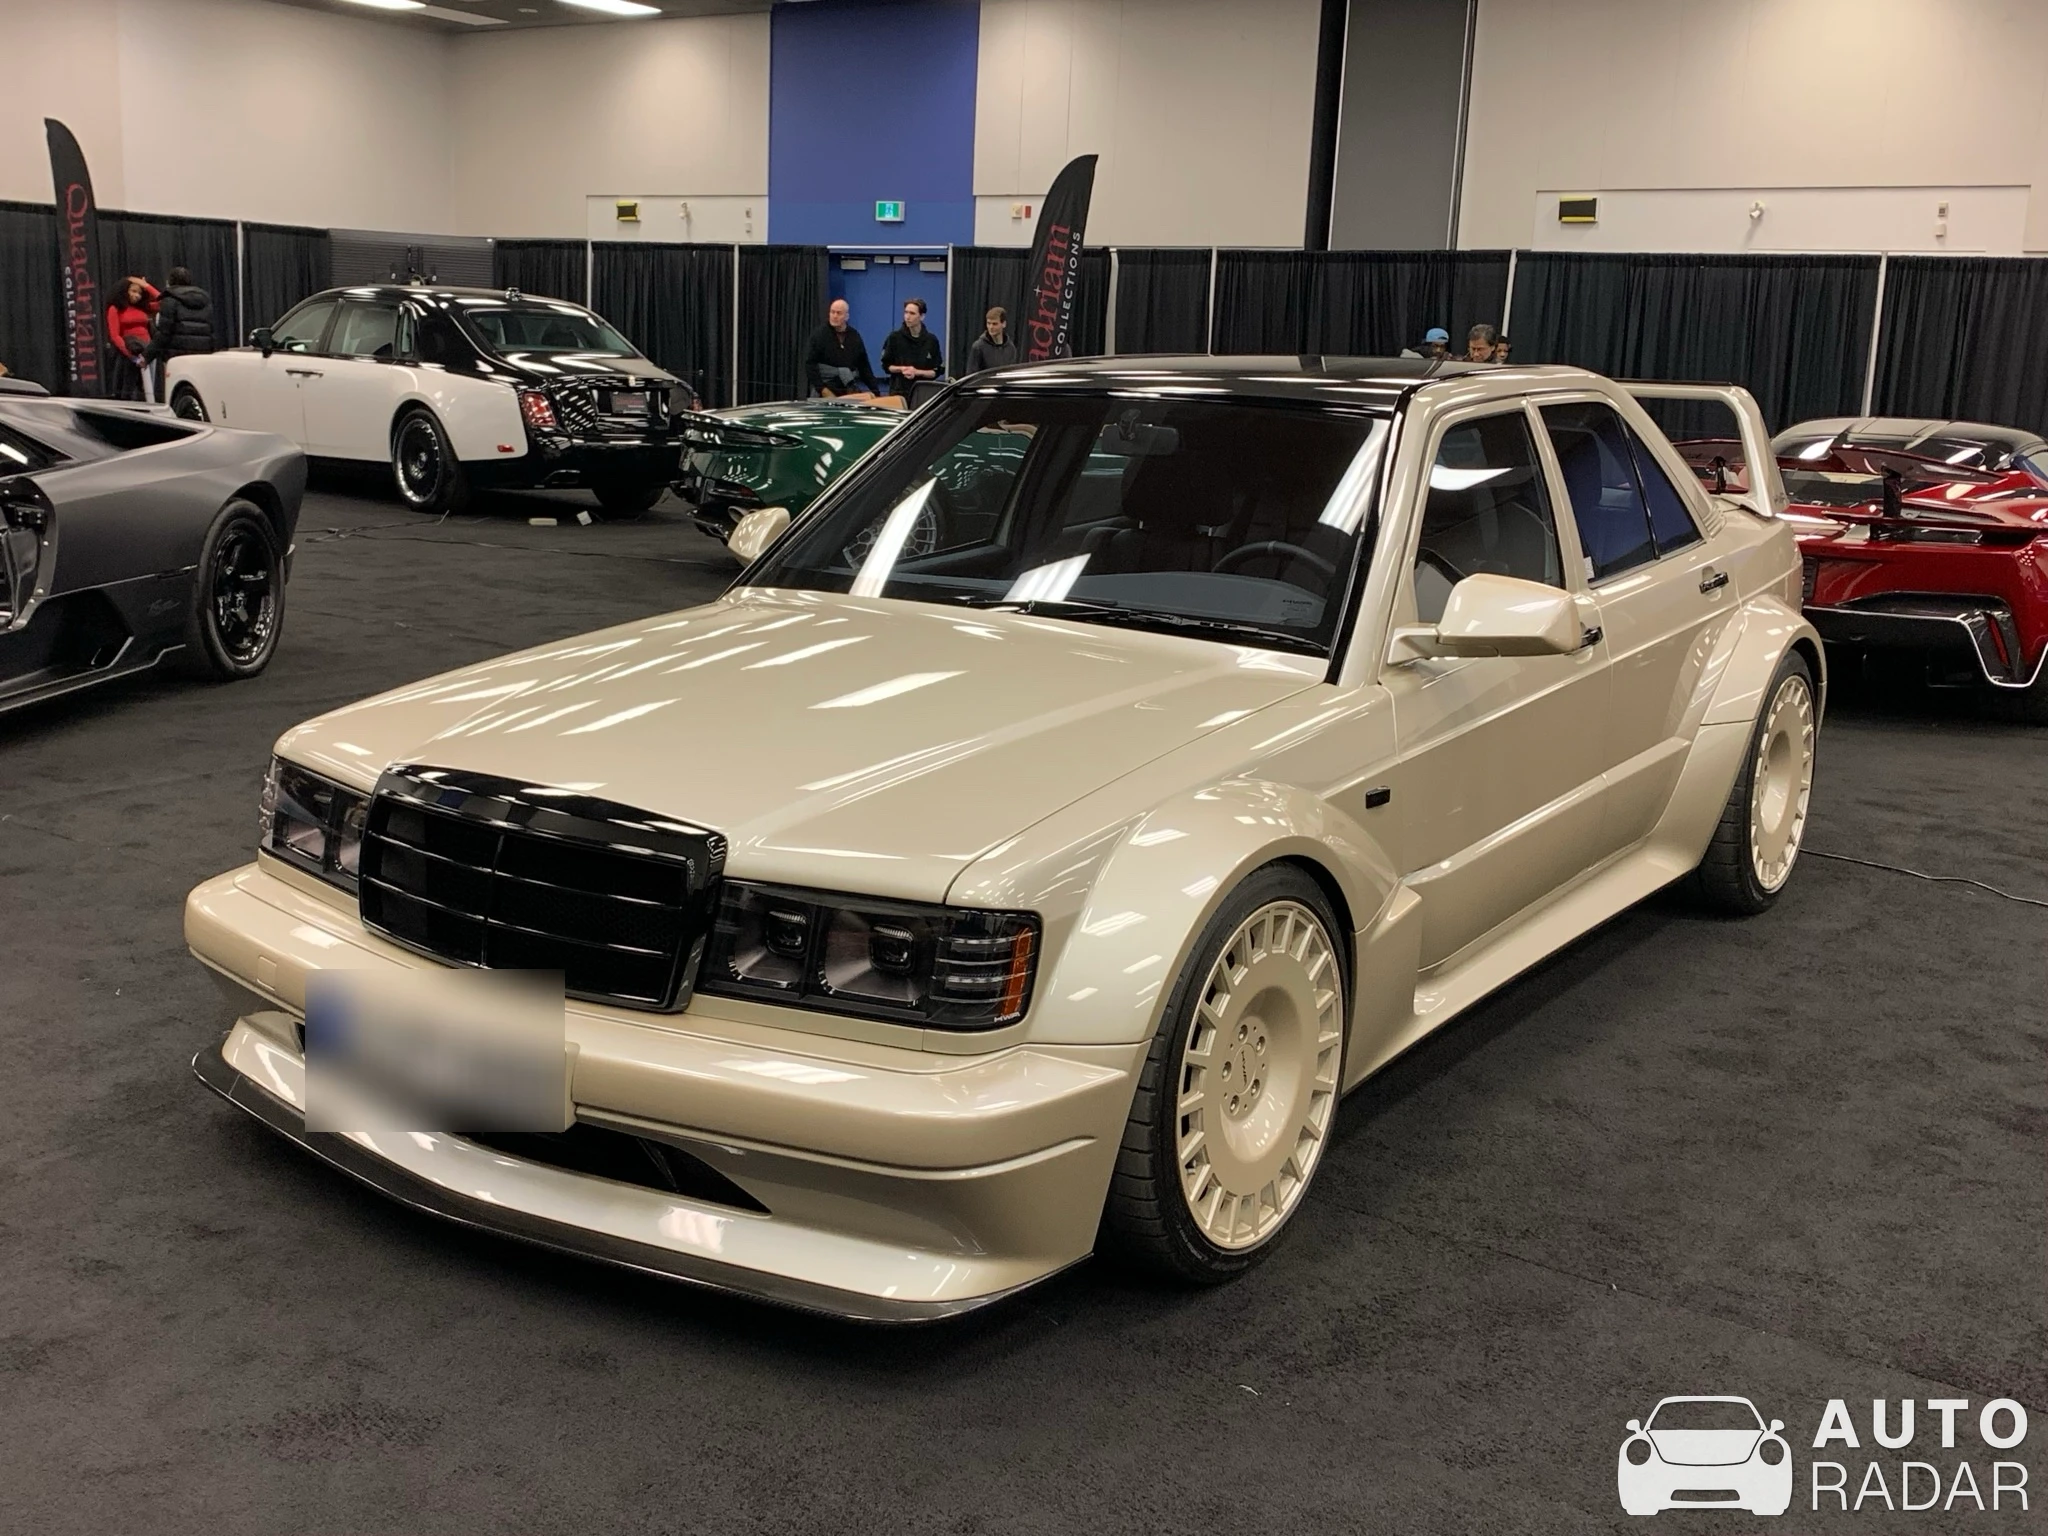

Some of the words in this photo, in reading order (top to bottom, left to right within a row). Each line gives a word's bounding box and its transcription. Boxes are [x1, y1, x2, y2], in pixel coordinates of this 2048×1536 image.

[64, 266, 78, 382] COLLECTIONS
[1028, 222, 1071, 363] adriam
[1055, 232, 1081, 356] COLLECTIONS
